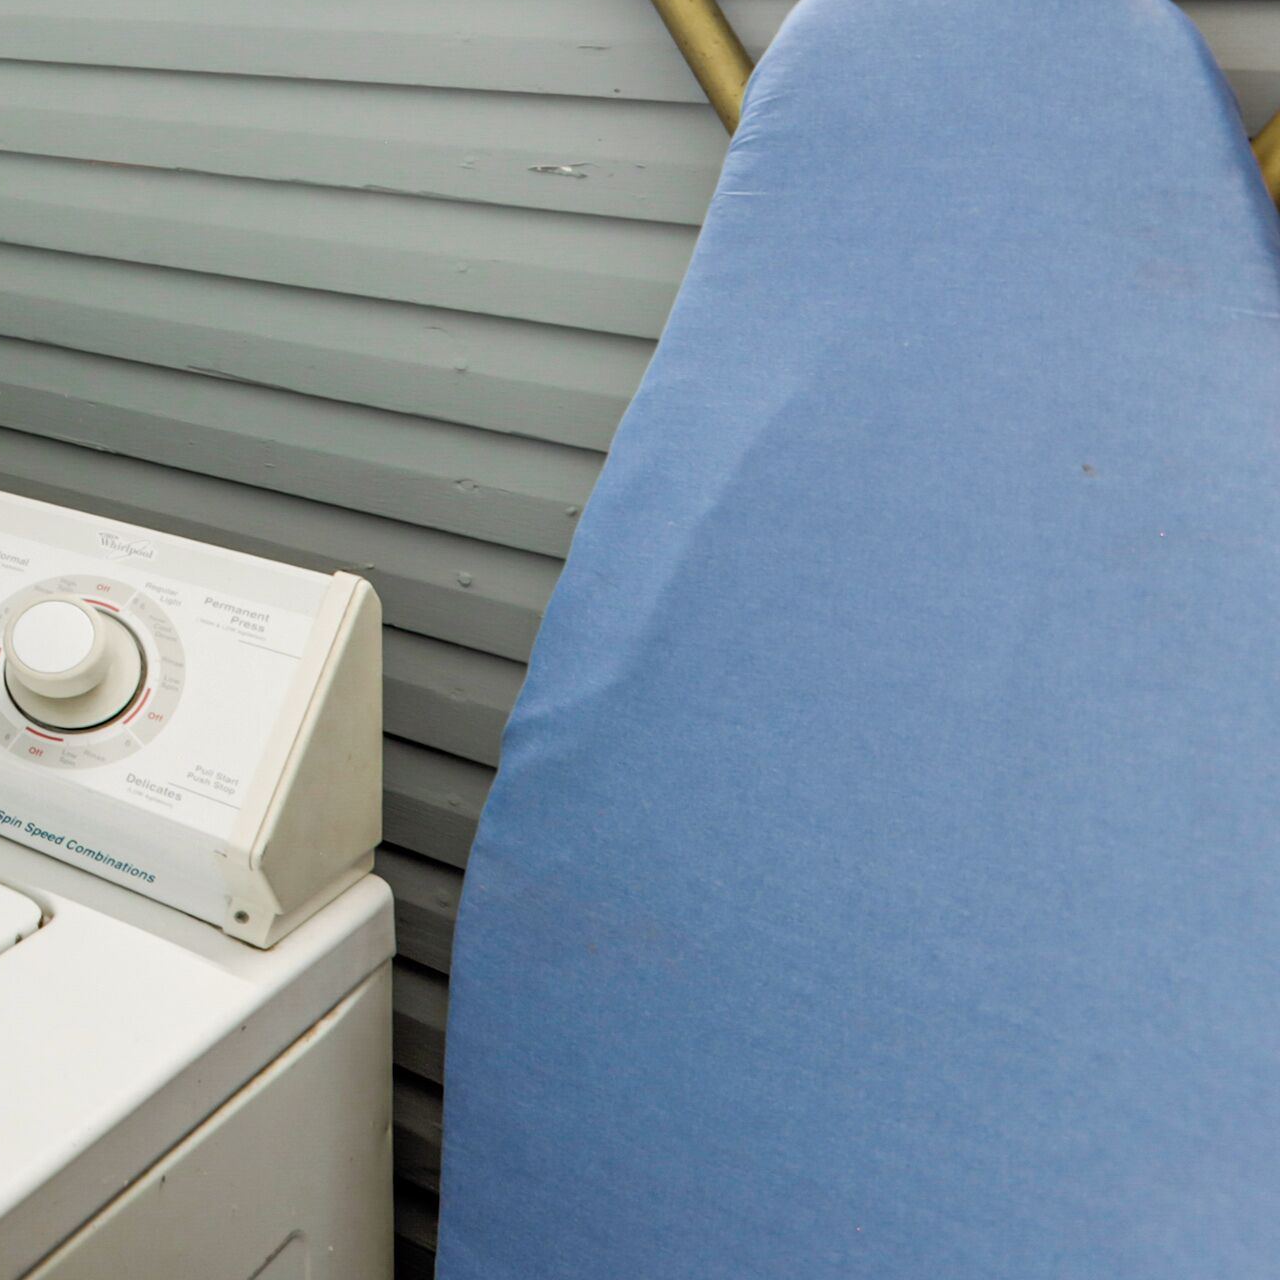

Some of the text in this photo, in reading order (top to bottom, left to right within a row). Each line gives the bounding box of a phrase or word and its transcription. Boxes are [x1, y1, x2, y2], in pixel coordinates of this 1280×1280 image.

[100, 536, 154, 560] Whirlpool
[96, 582, 111, 593] Off
[145, 581, 179, 596] Regular
[159, 595, 183, 607] Light
[204, 596, 270, 623] Permanent
[229, 615, 265, 633] Press
[147, 711, 164, 722] Off
[28, 745, 44, 757] Off
[186, 771, 236, 796] Push Stop
[194, 764, 239, 787] Pull Start
[126, 772, 183, 802] Delicates
[23, 821, 66, 846] Speed
[65, 838, 157, 884] Combinations
